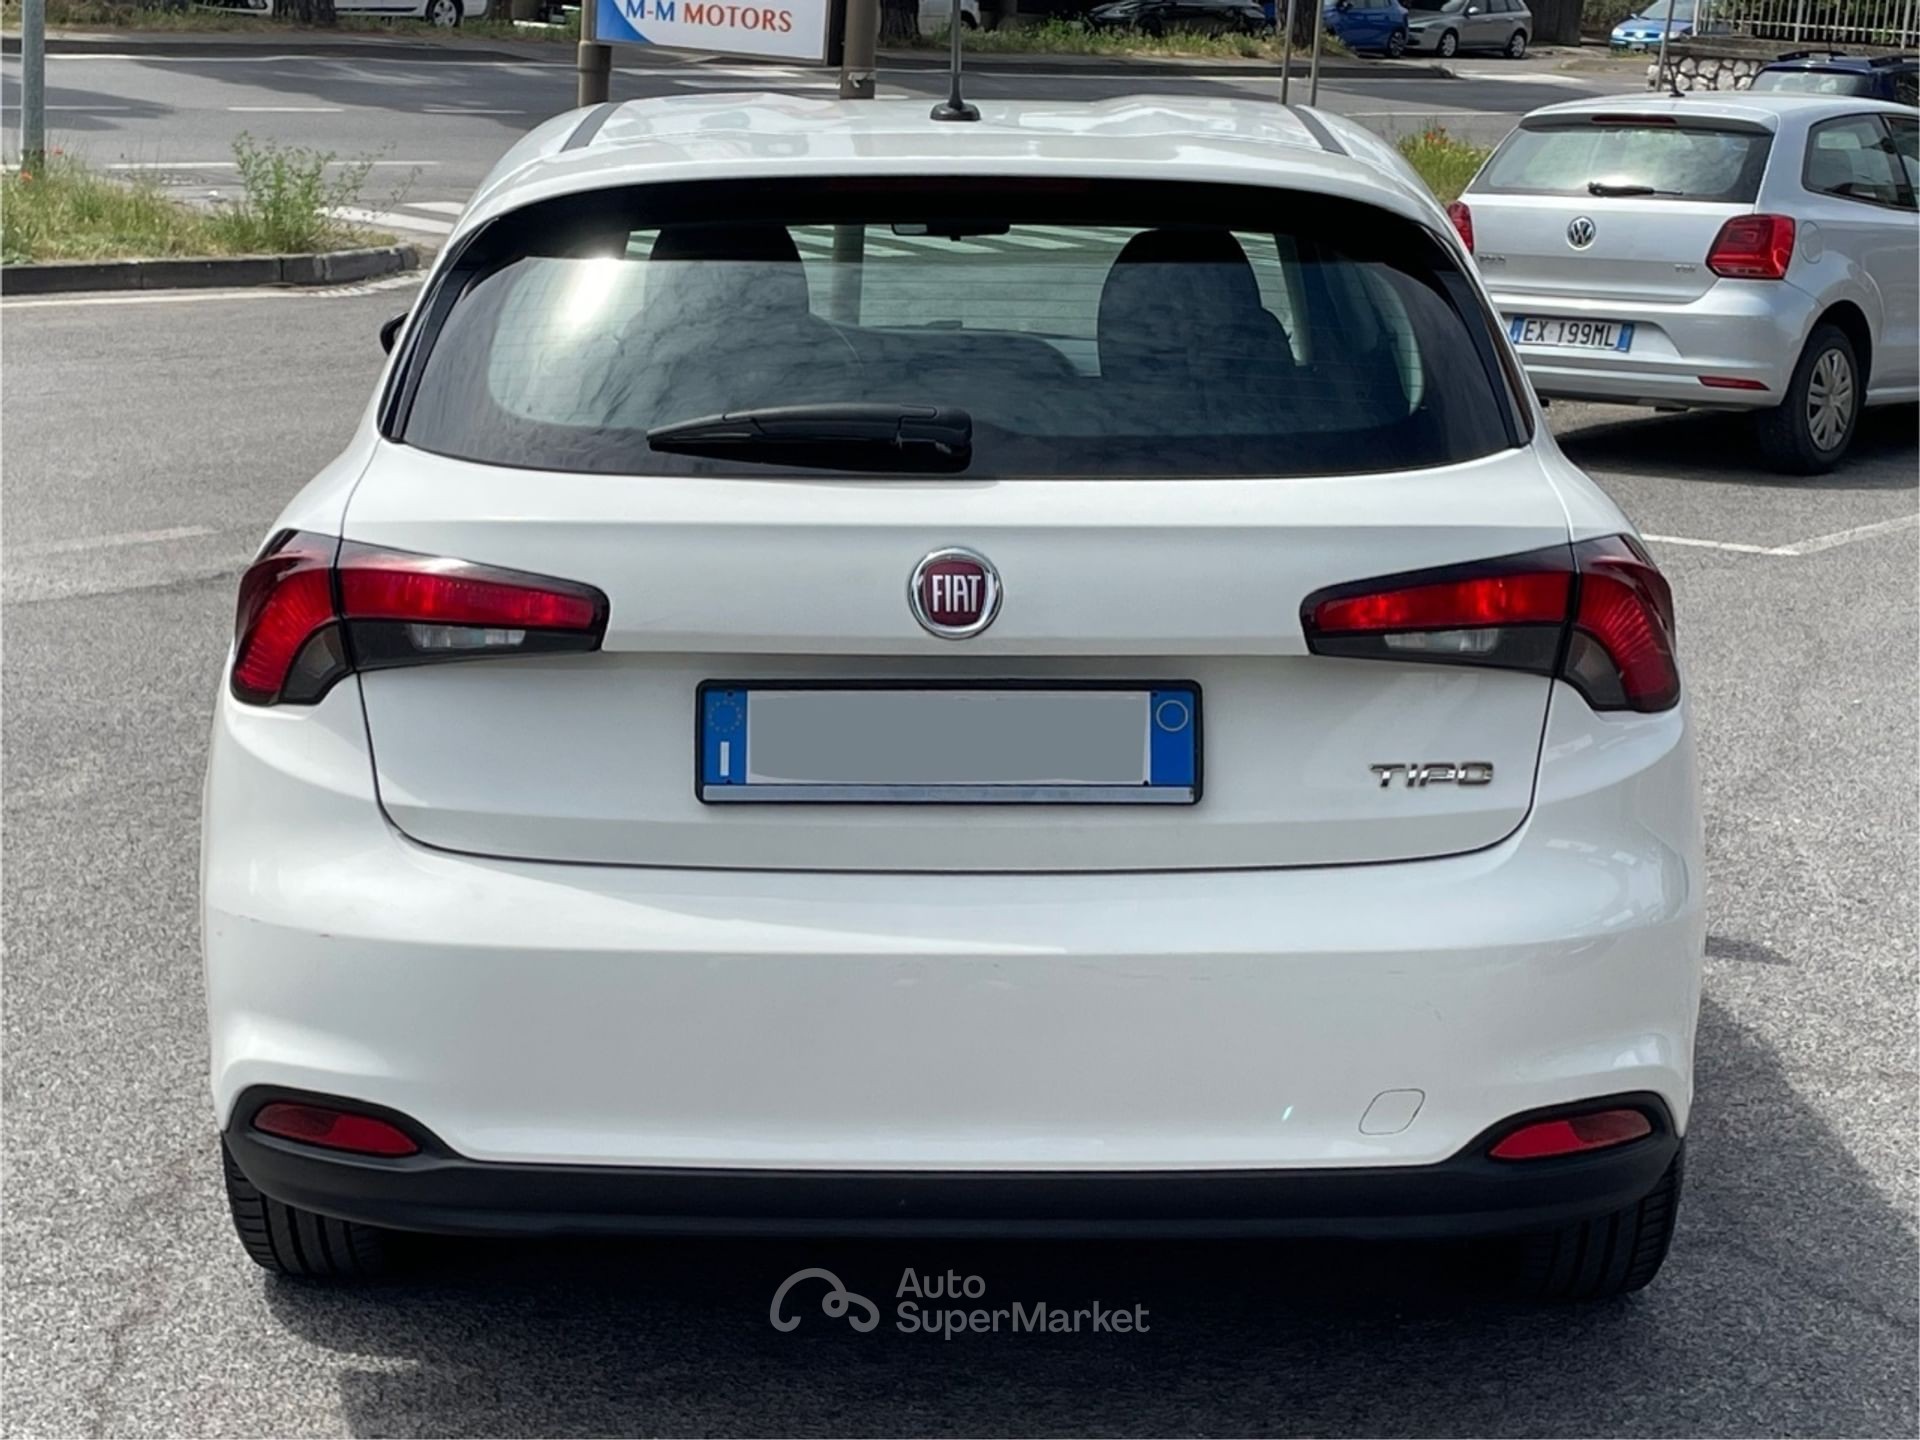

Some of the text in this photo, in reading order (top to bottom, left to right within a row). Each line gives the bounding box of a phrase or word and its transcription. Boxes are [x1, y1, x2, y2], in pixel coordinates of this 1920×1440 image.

[625, 0, 793, 33] M-M MOTORS
[1522, 320, 1615, 347] EX 199ML
[931, 574, 982, 613] FIAT
[1370, 762, 1494, 788] TIPO
